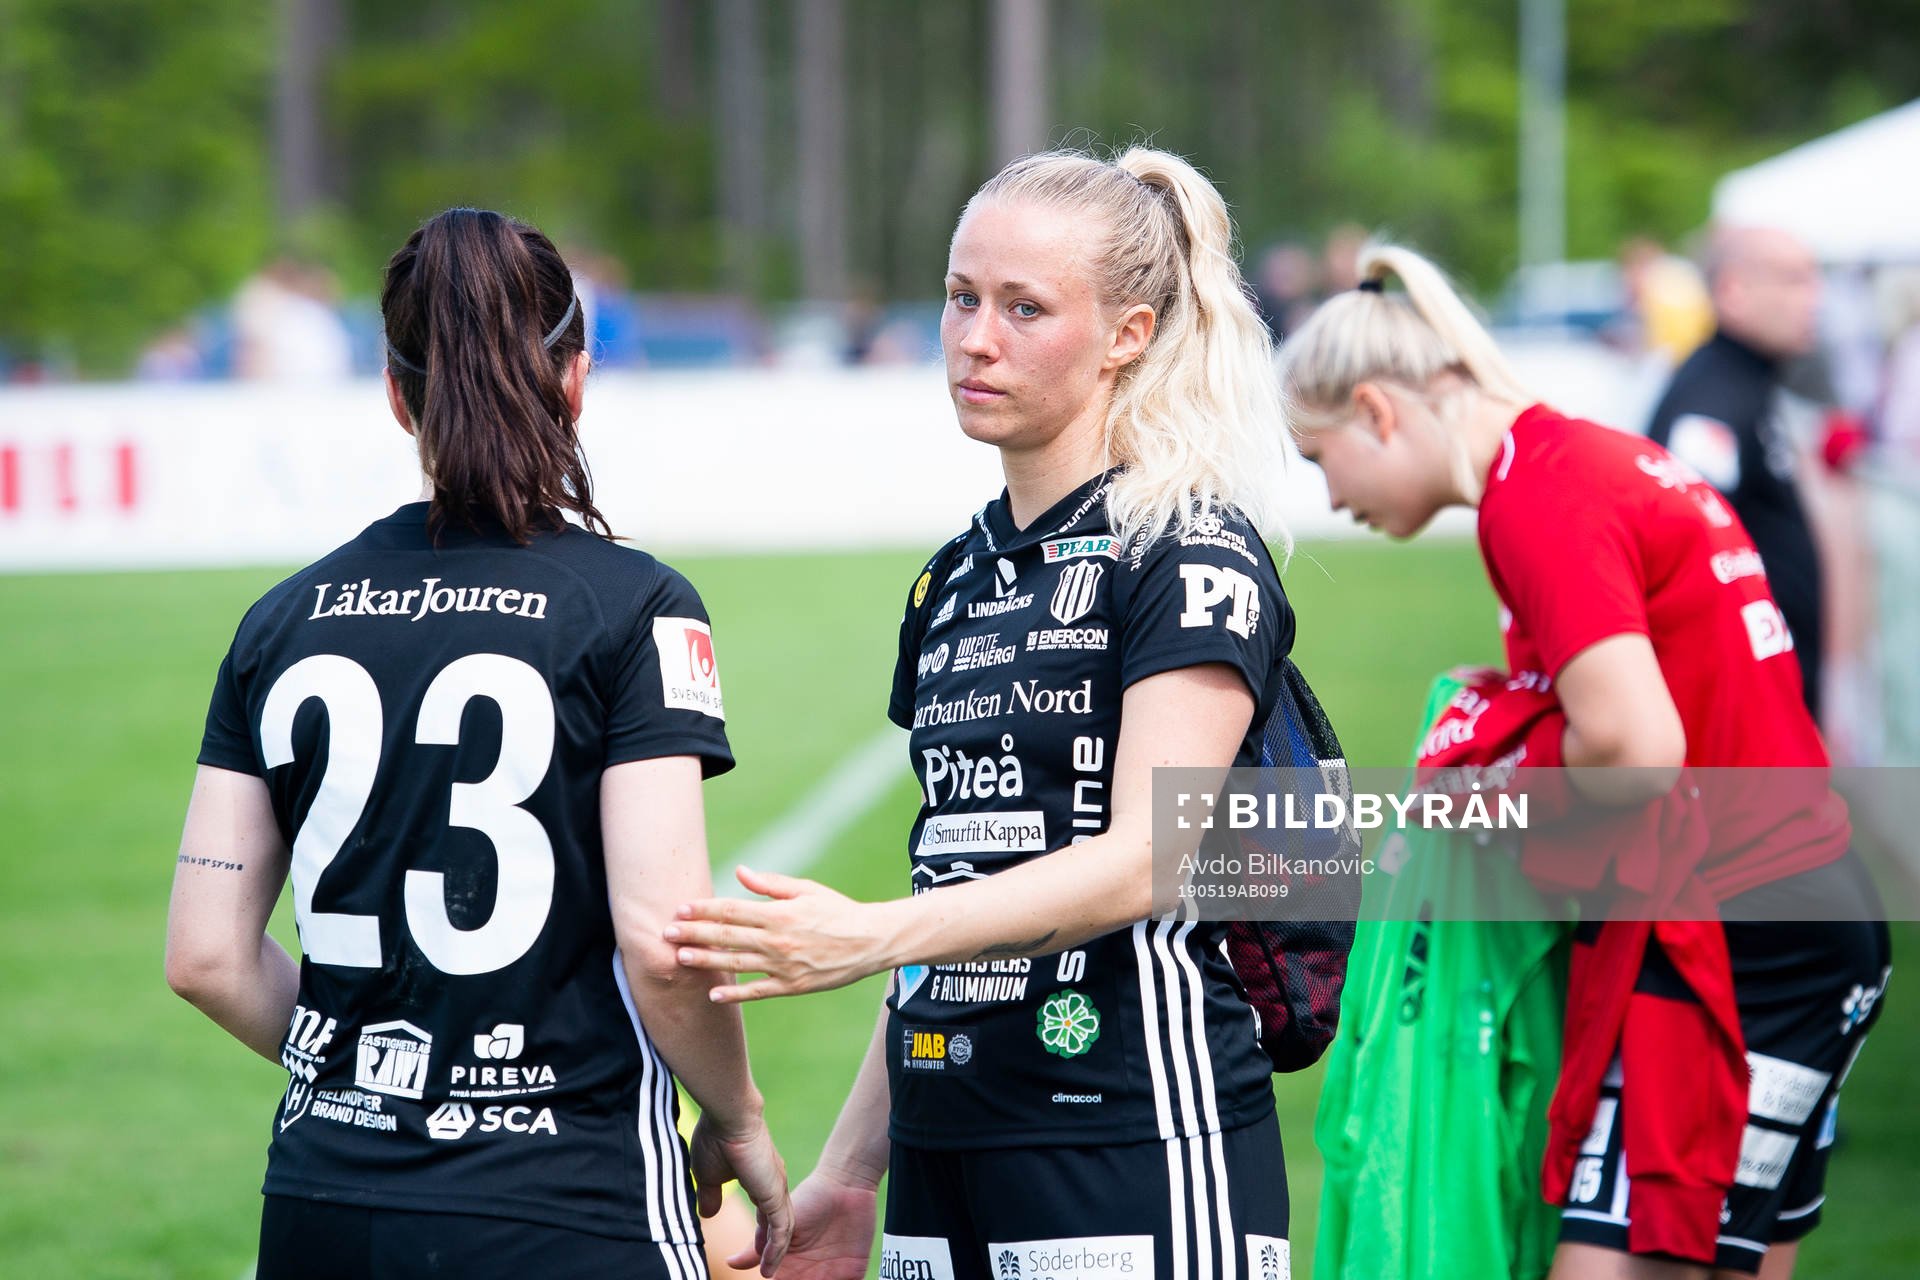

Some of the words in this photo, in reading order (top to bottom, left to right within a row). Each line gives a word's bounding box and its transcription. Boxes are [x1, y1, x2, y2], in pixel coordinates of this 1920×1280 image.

[1056, 539, 1112, 558] PEAB
[1180, 535, 1231, 549] SUMMER
[308, 578, 548, 622] LäkarJouren
[967, 593, 1035, 619] LINDBÄCKS
[976, 632, 1000, 651] PITE
[1038, 628, 1109, 644] ENERCON
[969, 644, 1017, 670] ENERGI
[1005, 679, 1094, 715] Nord
[922, 733, 1024, 807] Piteå
[260, 653, 555, 976] 23
[934, 821, 982, 845] Smurfit
[984, 823, 1043, 849] Kappa
[930, 975, 940, 1000] &
[941, 975, 1029, 1002] ALUMINIUM
[358, 1034, 418, 1052] FASTIGHETS
[417, 1043, 431, 1054] AB
[912, 1032, 945, 1059] JIAB
[451, 1064, 557, 1085] PIREVA
[1051, 1092, 1103, 1104] climacool
[311, 1100, 354, 1123] BRAND
[354, 1109, 398, 1132] DESIGN
[480, 1105, 558, 1136] SCA
[1028, 1247, 1134, 1273] Söderberg
